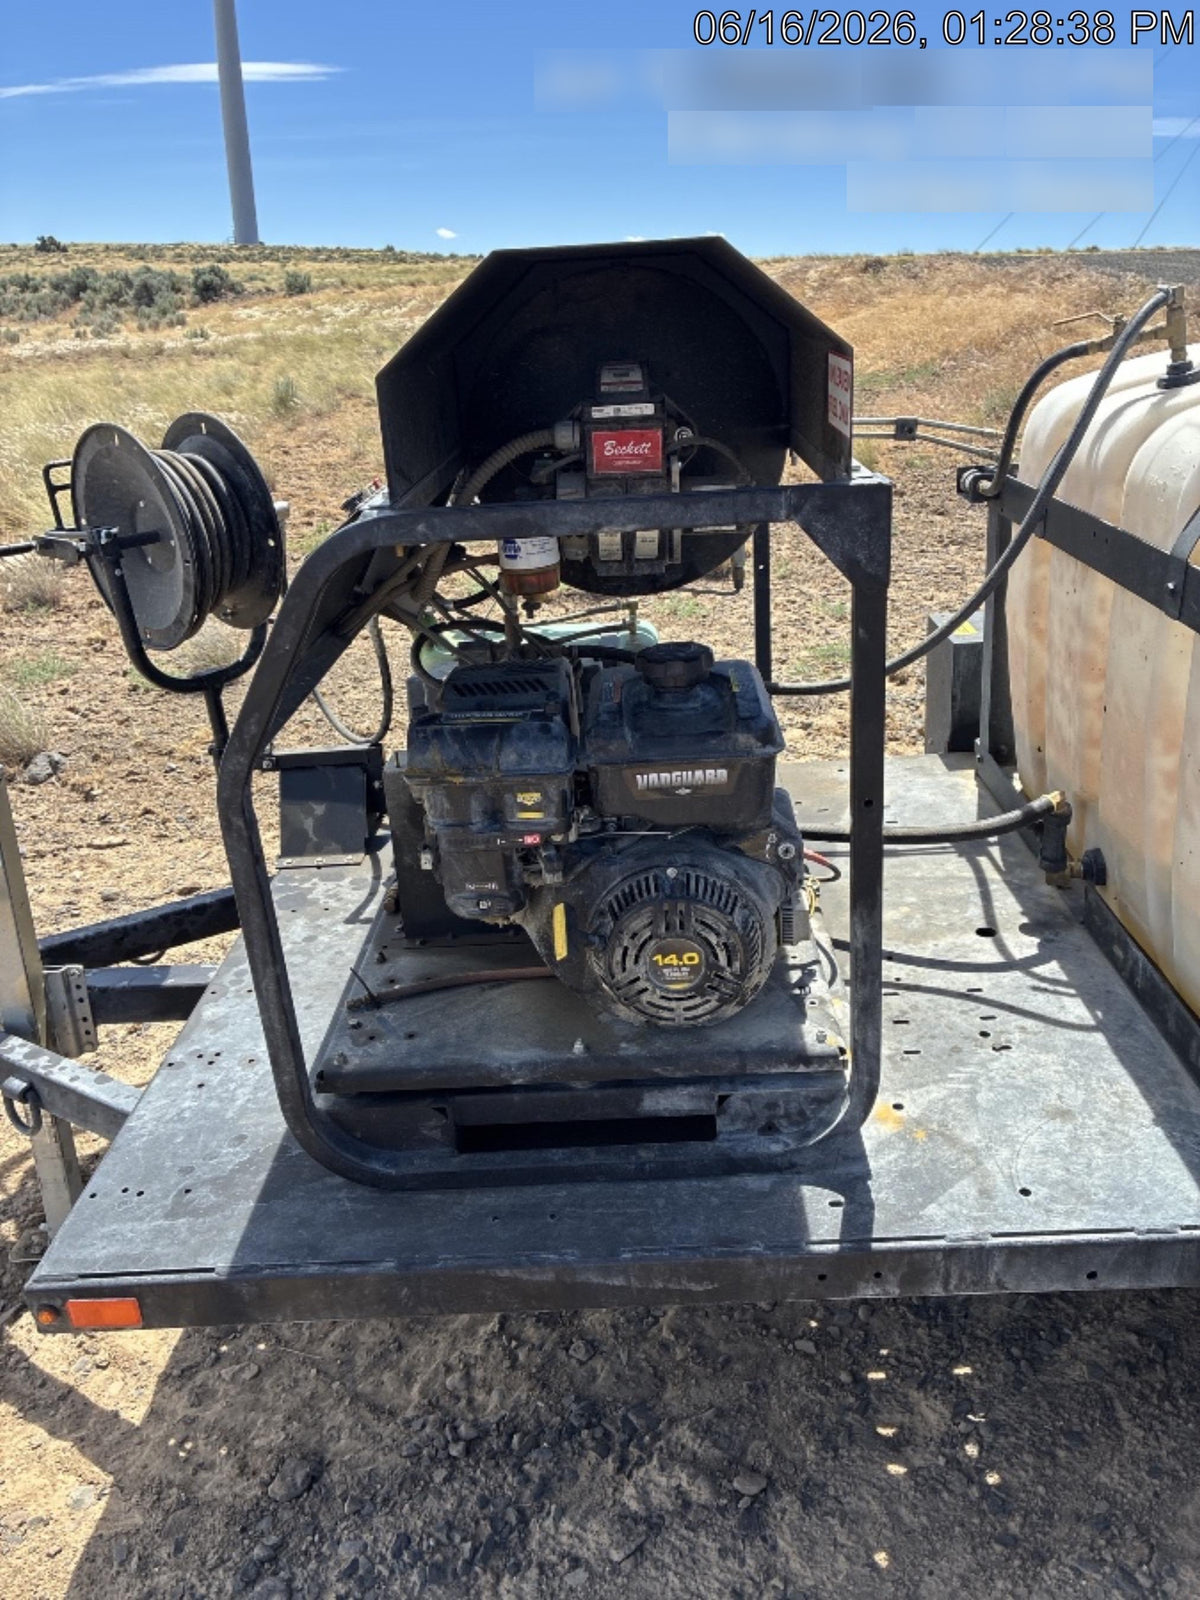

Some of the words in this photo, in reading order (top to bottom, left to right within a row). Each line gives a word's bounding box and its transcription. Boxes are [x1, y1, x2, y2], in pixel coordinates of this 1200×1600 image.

[603, 440, 652, 456] Beckett
[635, 768, 728, 790] VANGUARD
[652, 951, 700, 966] 14.0
